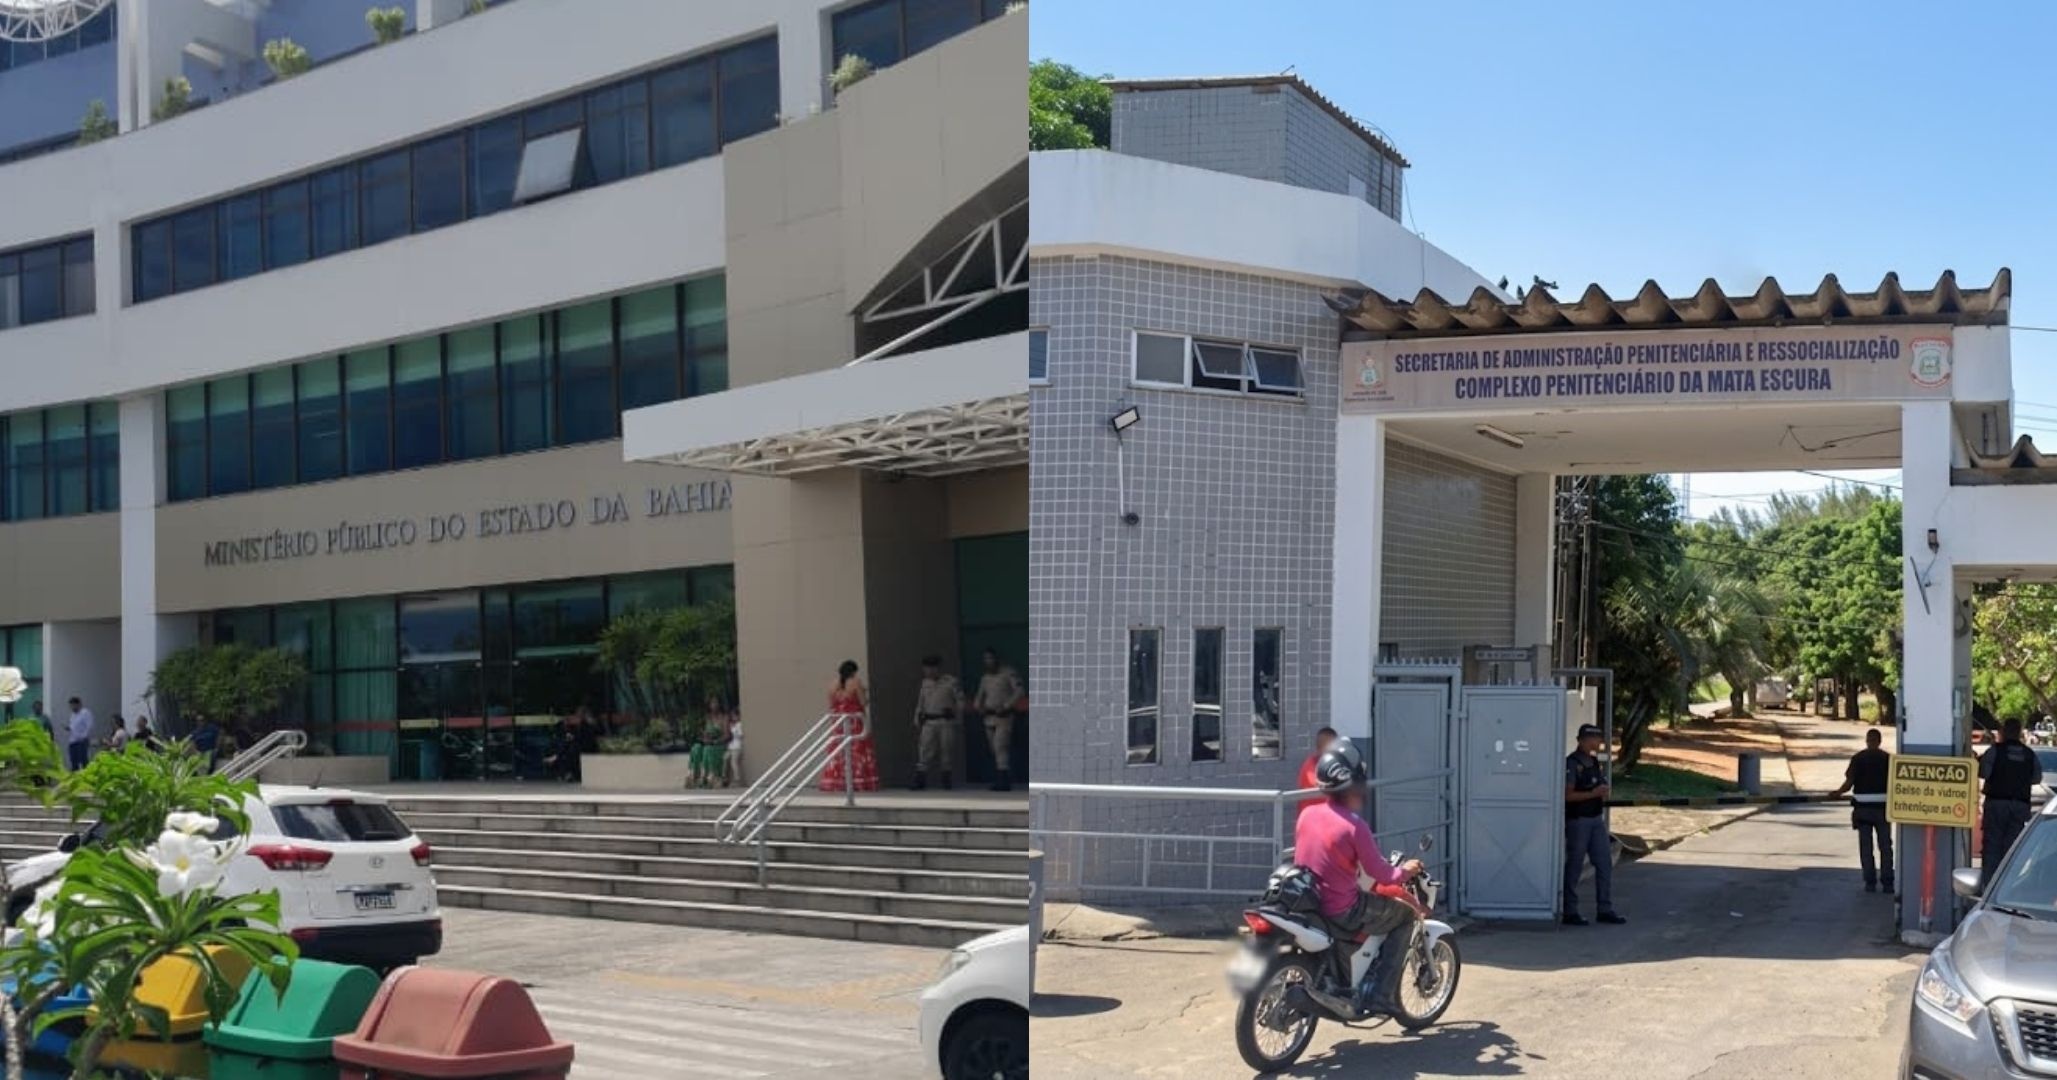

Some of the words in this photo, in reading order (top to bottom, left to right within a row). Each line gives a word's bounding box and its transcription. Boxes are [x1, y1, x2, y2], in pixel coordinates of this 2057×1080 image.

[1395, 352, 1479, 373] SECRETARIA
[1483, 350, 1500, 369] DE
[1503, 342, 1623, 369] ADMINISTRAÇÃO
[1627, 340, 1742, 364] PENITENCIÁRIA
[1746, 342, 1754, 362] E
[1758, 335, 1900, 363] RESSOCIALIZAÇÃO
[1455, 374, 1541, 399] COMPLEXO
[1546, 368, 1675, 396] PENITENCIÁRIO
[1680, 370, 1703, 393] DA
[1708, 369, 1755, 392] MATA
[1760, 368, 1832, 391] ESCURA
[204, 529, 318, 566] MINISTÉRIO
[328, 521, 416, 555] PÚBLICO
[430, 513, 466, 543] DO
[477, 500, 576, 538] ESTADO
[590, 493, 629, 525] DA
[647, 480, 733, 518] BAHIA
